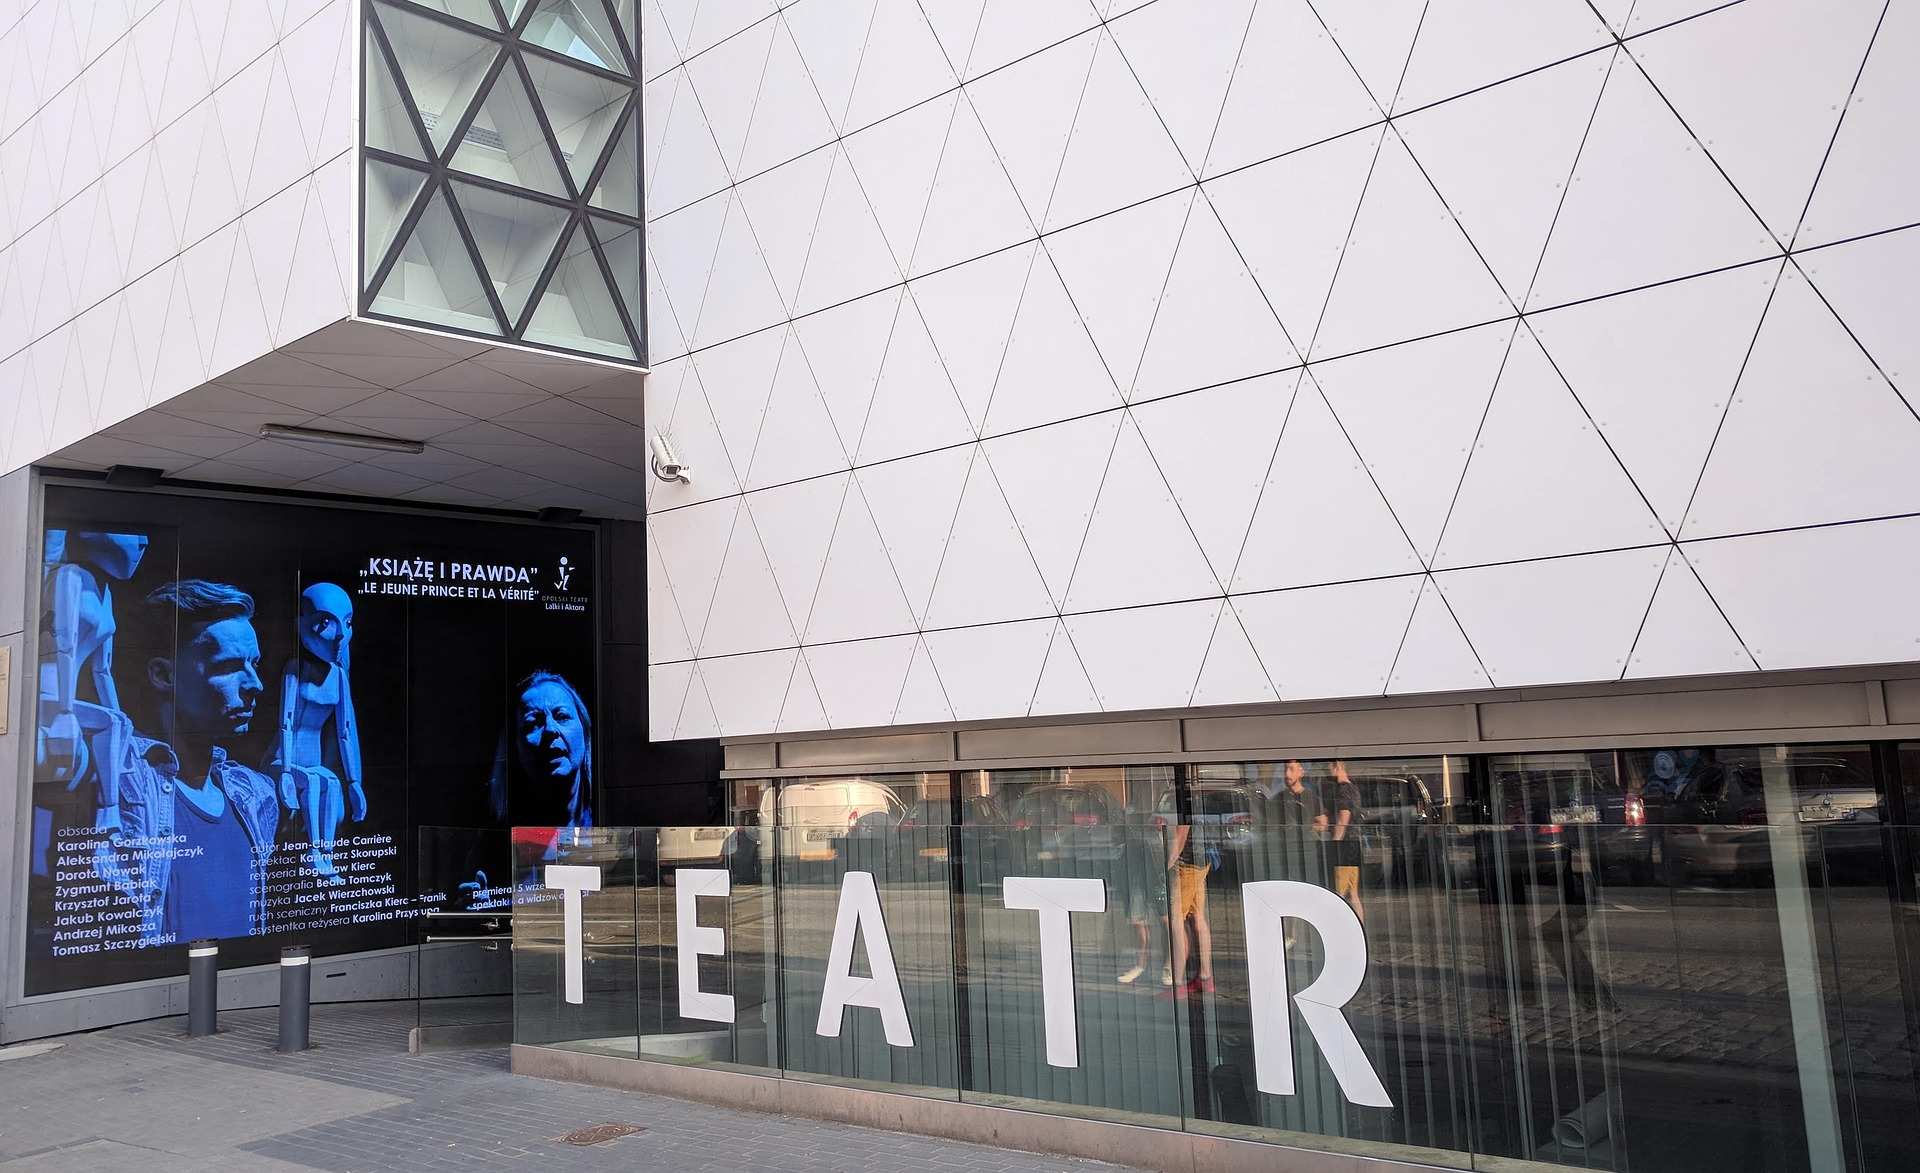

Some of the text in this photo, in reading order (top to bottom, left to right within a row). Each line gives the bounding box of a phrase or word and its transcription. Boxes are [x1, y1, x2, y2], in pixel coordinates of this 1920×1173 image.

[440, 562, 445, 578] I
[451, 562, 538, 583] PRAWDA”
[380, 583, 418, 596] JEUNE
[422, 585, 464, 598] PRINCE
[467, 587, 480, 598] ET
[482, 588, 496, 599] LA
[500, 587, 539, 600] VÉRITÉ”
[57, 839, 110, 852] Karolina
[282, 838, 350, 851] Jean-Claude
[352, 834, 392, 846] Carrière
[56, 852, 128, 866] Aleksandra
[350, 846, 397, 858] Skorupski
[56, 864, 146, 882] Dorota Nowak
[351, 862, 376, 872] Kierc
[348, 872, 392, 884] Tomczyk
[56, 882, 110, 898] Zygmunt
[294, 892, 326, 904] Jacek
[328, 884, 394, 900] Wierzchowski
[55, 894, 151, 912] Krzysztof Jarota
[276, 906, 328, 919] sceniczny
[330, 900, 382, 912] Franciszka
[384, 897, 408, 906] Kierc
[54, 906, 164, 926] Jakub Kowalczyk
[352, 912, 392, 924] Karolina
[53, 922, 156, 942] Andrzej Mikosza
[52, 932, 176, 956] Tomasz Szczygielski
[545, 865, 1394, 1107] TEATR
